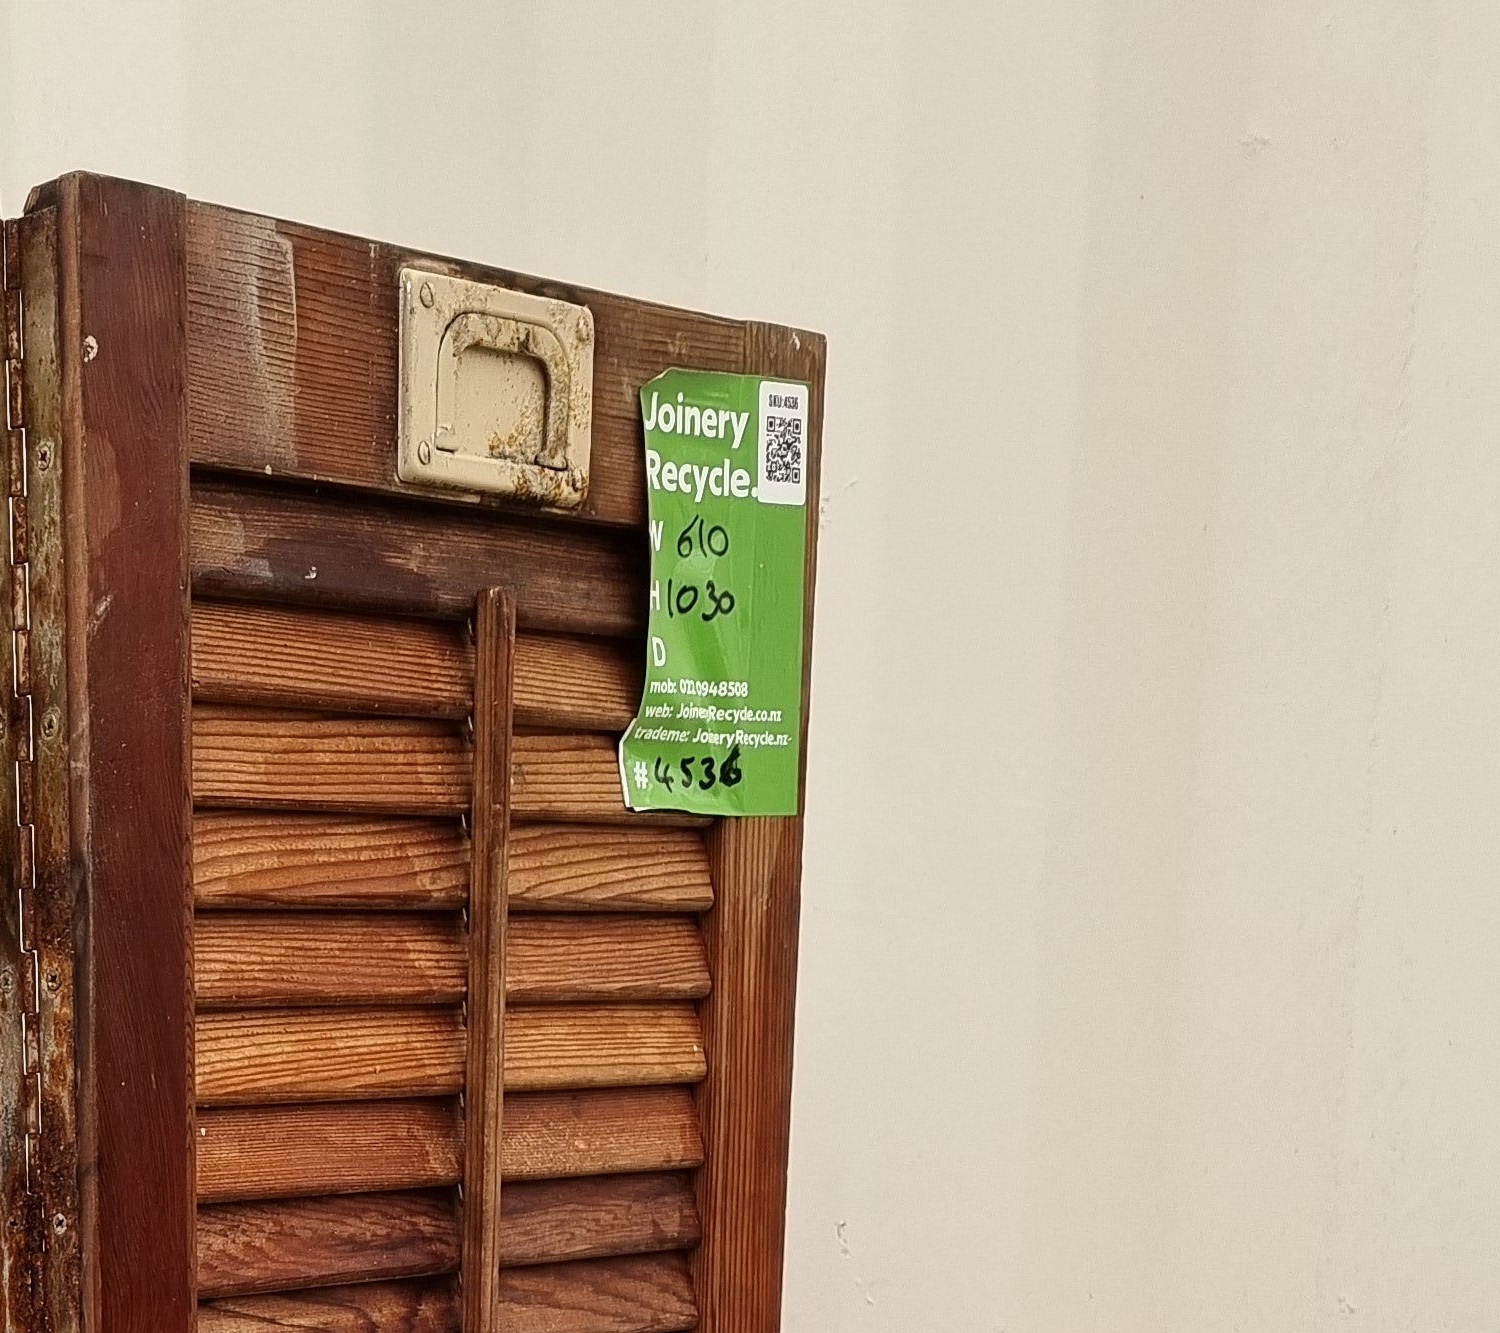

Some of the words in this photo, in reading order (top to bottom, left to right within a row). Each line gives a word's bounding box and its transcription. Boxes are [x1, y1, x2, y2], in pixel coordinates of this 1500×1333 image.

[644, 391, 749, 449] Joinery
[646, 450, 759, 503] Recycle.
[677, 514, 729, 558] 610
[650, 579, 660, 611] H
[667, 578, 735, 622] 1030
[651, 637, 666, 667] D
[650, 678, 677, 694] mob:
[645, 703, 674, 718] web:
[634, 726, 691, 742] trademe:
[654, 745, 742, 793] 4536
